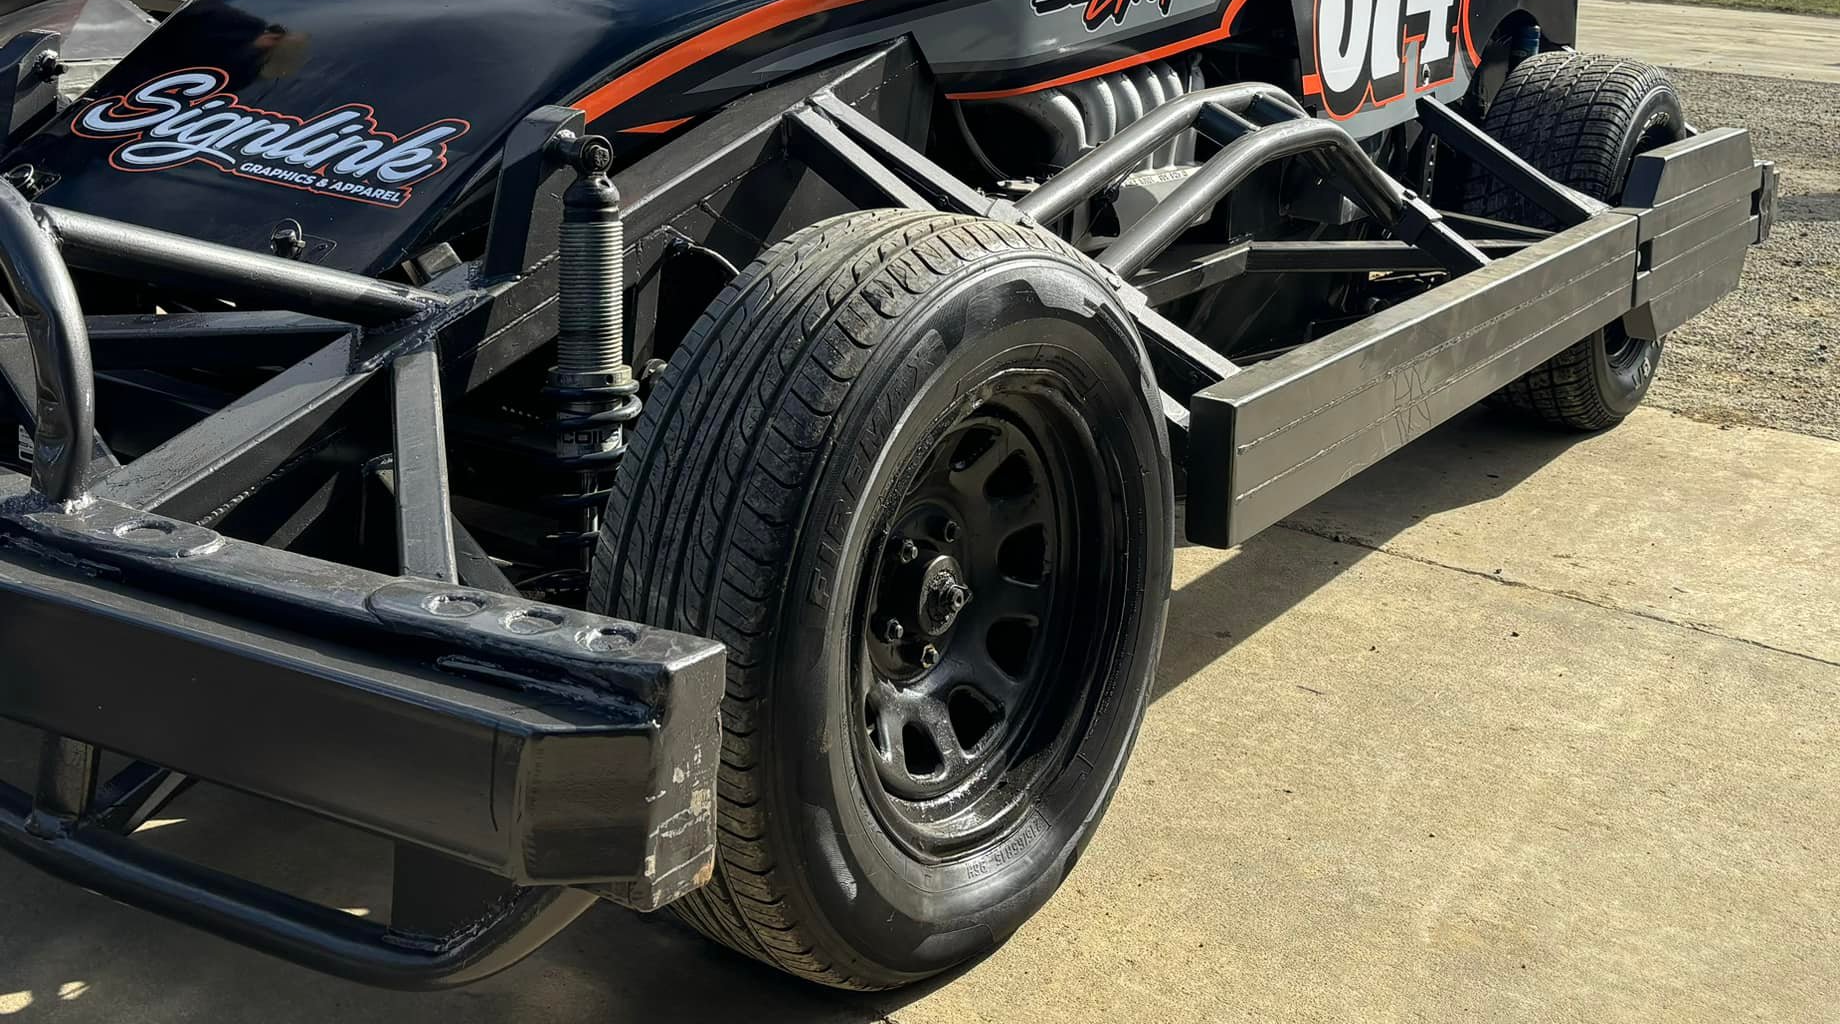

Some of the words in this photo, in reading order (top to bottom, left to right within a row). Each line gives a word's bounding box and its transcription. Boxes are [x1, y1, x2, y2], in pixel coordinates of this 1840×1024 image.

[82, 72, 457, 182] Signlink
[240, 162, 315, 187] GRAPHICS
[315, 176, 329, 189] &
[329, 180, 401, 203] APPAREL
